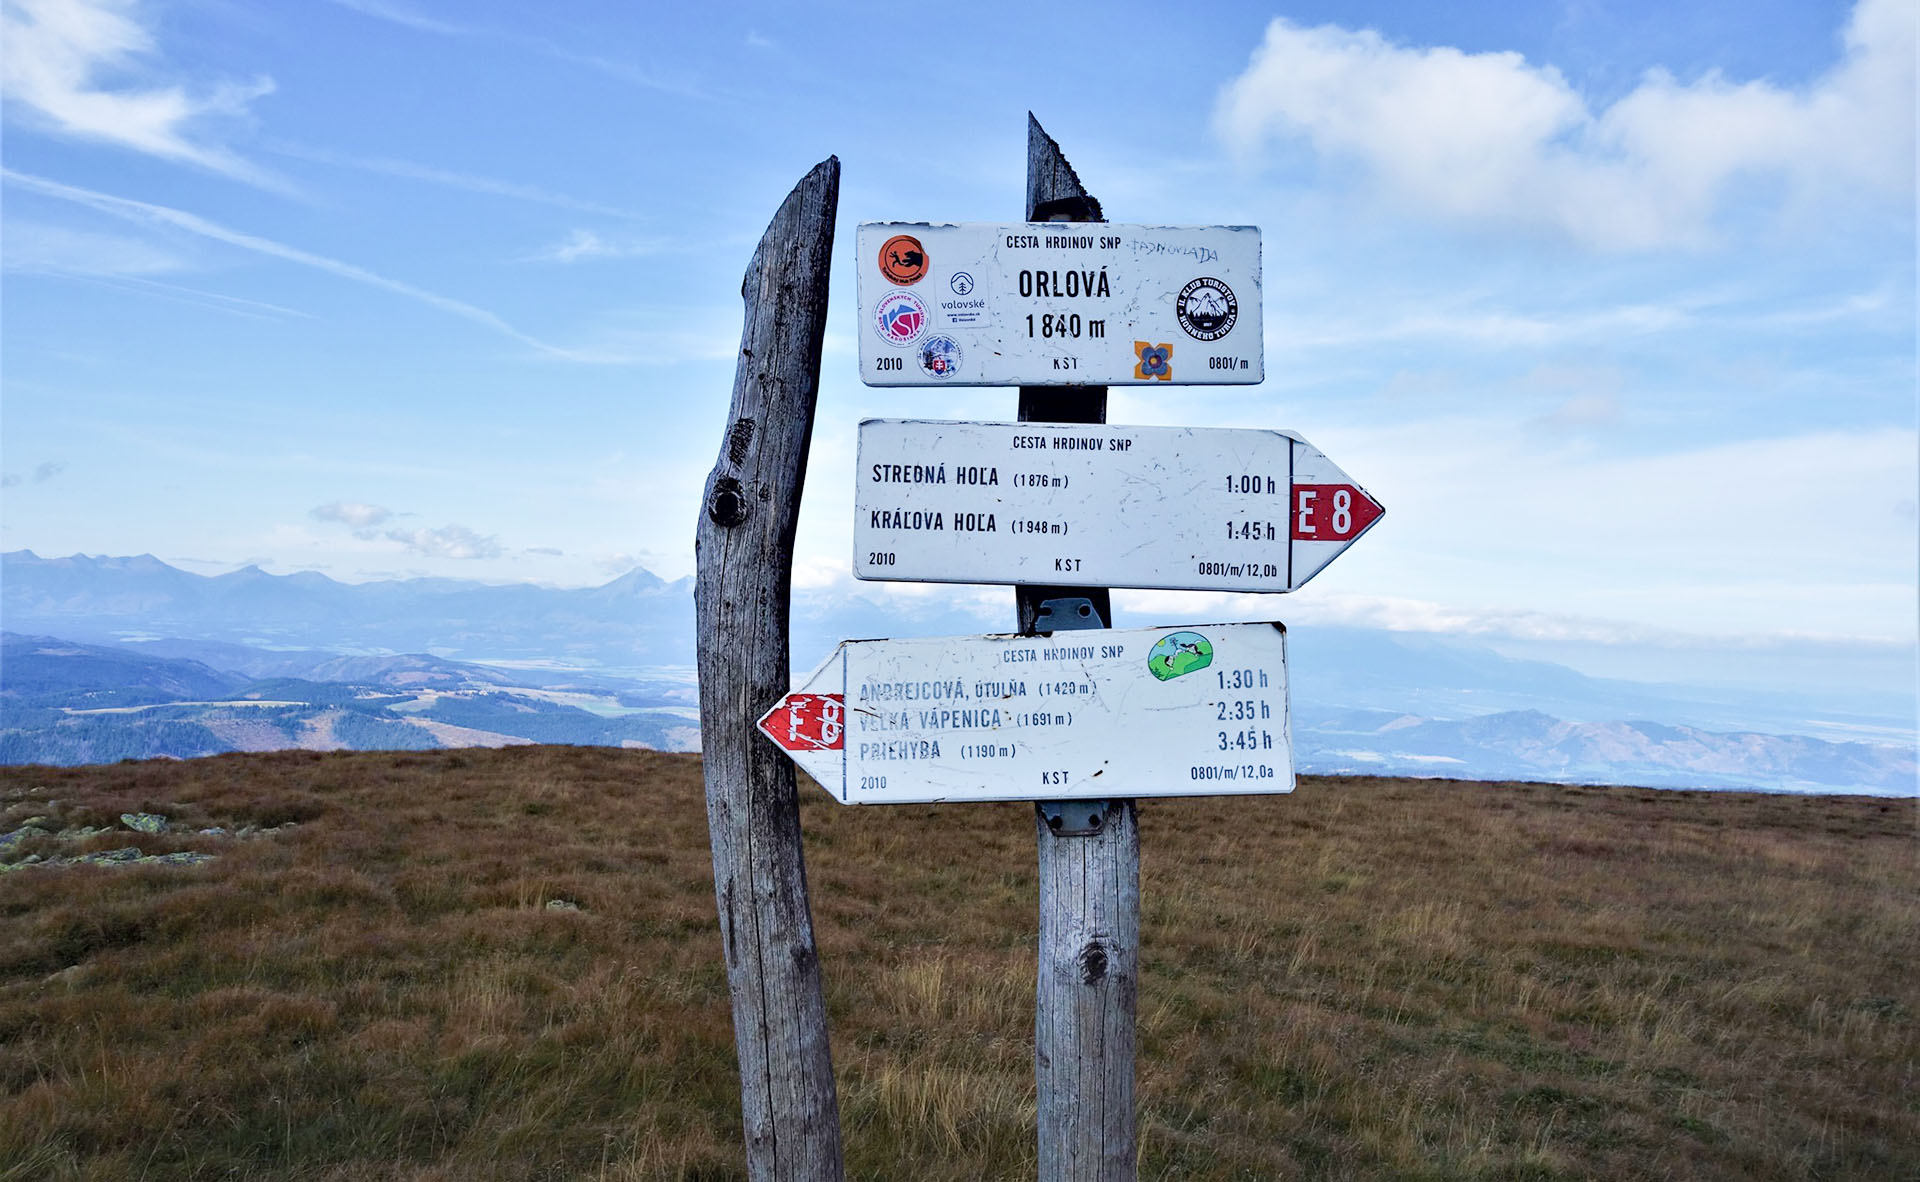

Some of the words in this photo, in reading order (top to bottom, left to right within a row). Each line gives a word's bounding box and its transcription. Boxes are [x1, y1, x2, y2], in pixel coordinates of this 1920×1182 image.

[1006, 235, 1039, 249] CESTA
[1046, 236, 1094, 249] HRDINOV
[1100, 236, 1121, 249] SNP
[1019, 265, 1111, 298] ORLOVÁ
[1181, 279, 1202, 298] KLUB
[1202, 278, 1236, 307] TURISTOV
[941, 299, 985, 309] volovské
[1089, 319, 1105, 338] m
[1214, 314, 1236, 338] TURCA
[876, 357, 903, 371] 2010
[1053, 357, 1078, 370] KST
[1013, 435, 1047, 449] CESTA
[1053, 437, 1104, 451] HRDINOV
[1109, 438, 1132, 452] SNP
[872, 462, 946, 484] STREDNÁ
[1226, 475, 1262, 494] 1:00
[1267, 476, 1275, 494] h
[871, 507, 944, 530] KRÁĽOVA
[1298, 490, 1317, 533] E
[1332, 489, 1351, 535] 8
[1226, 521, 1261, 540] 1:45
[1267, 521, 1275, 541] h
[869, 552, 896, 566] 2010
[1055, 558, 1082, 572] KST
[1003, 649, 1037, 663] CESTA
[1043, 646, 1095, 661] HRDINOV
[1101, 645, 1124, 659] SNP
[975, 678, 1027, 698] ÚTULŇA
[1217, 669, 1253, 689] 1:30
[1259, 669, 1268, 688] h
[920, 707, 1001, 729] VÁPENICA
[1217, 700, 1255, 721] 2:35
[1261, 700, 1270, 719] h
[821, 699, 840, 745] 8
[1218, 730, 1257, 751] 3:45
[1263, 730, 1272, 749] h
[861, 776, 887, 790] 2010
[1042, 771, 1069, 785] KST
